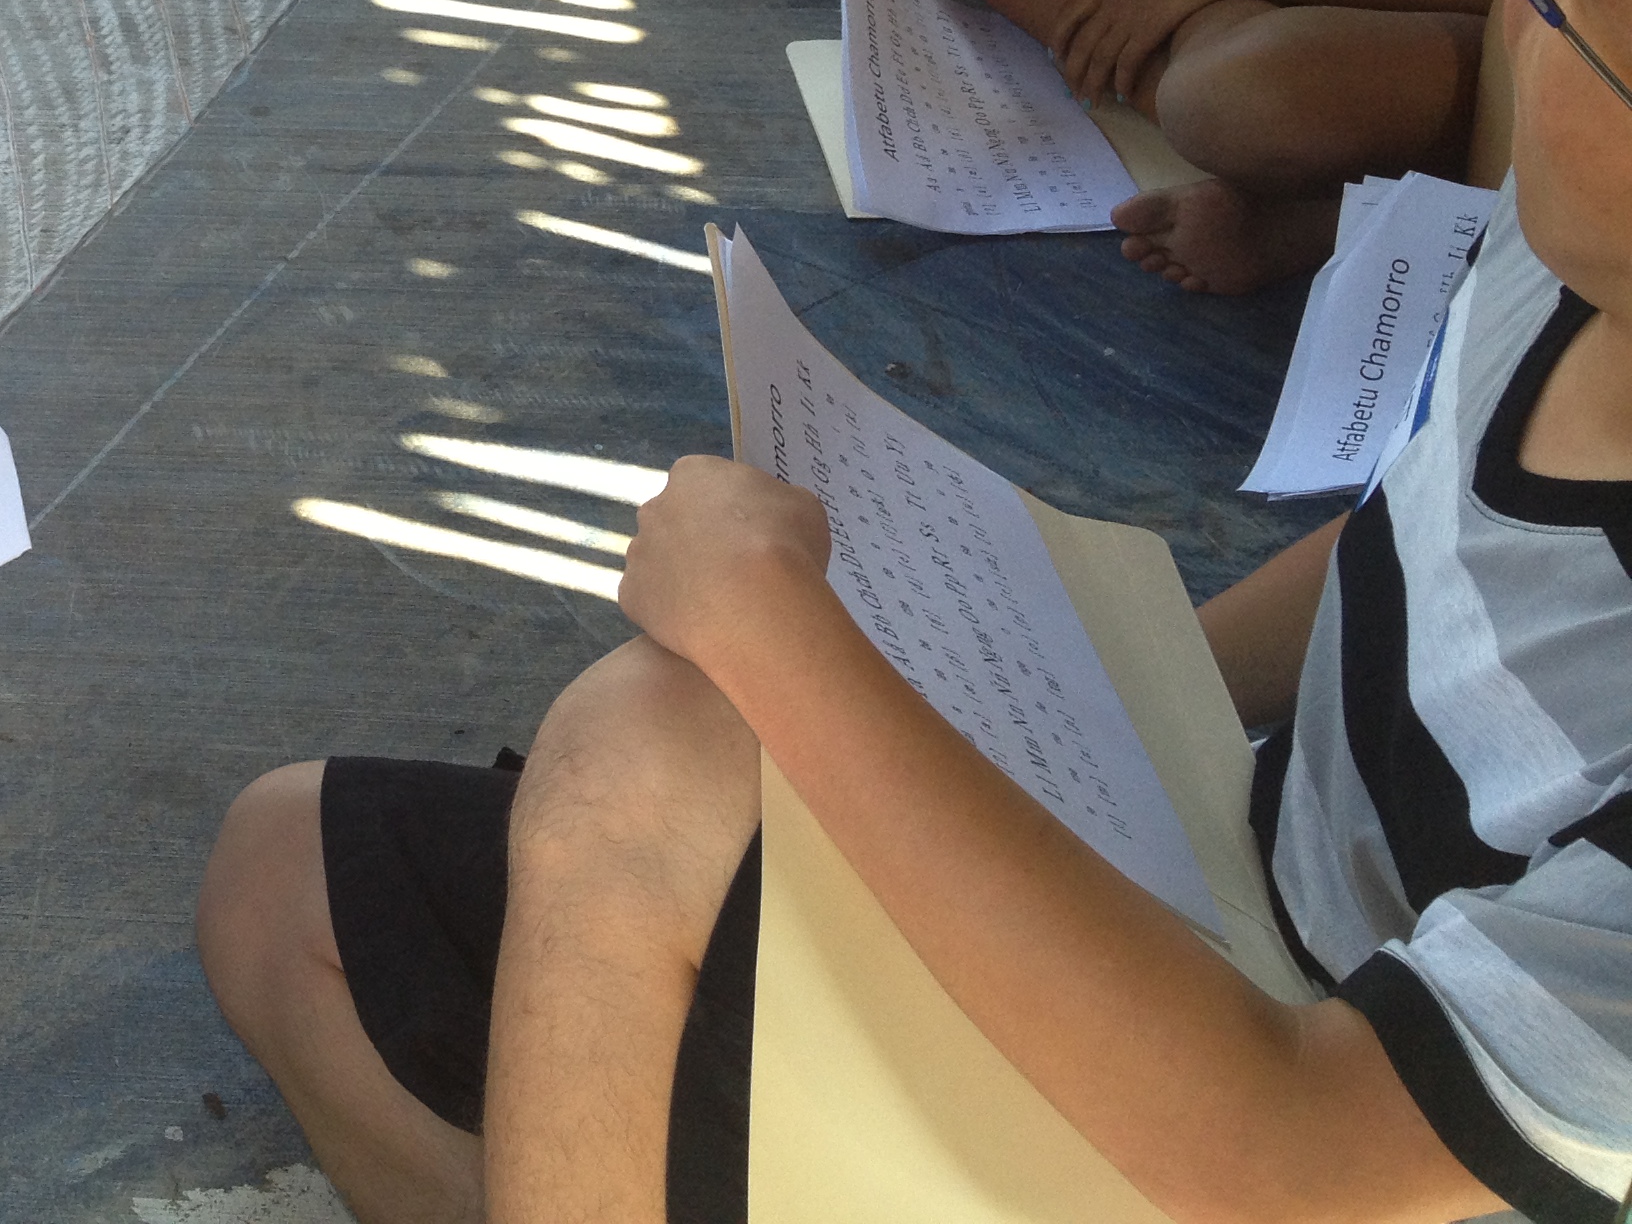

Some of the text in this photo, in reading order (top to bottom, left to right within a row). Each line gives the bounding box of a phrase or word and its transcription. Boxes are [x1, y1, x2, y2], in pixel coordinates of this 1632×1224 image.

[874, 82, 899, 162] Atfabetu
[1332, 388, 1379, 462] Atfabetu
[1359, 258, 1410, 381] Chamorro
[919, 521, 939, 543] Ss
[832, 538, 863, 570] Dd
[931, 546, 953, 573] Rr
[944, 574, 967, 598] Pp
[958, 599, 979, 624] Oo
[871, 614, 899, 640] Bb
